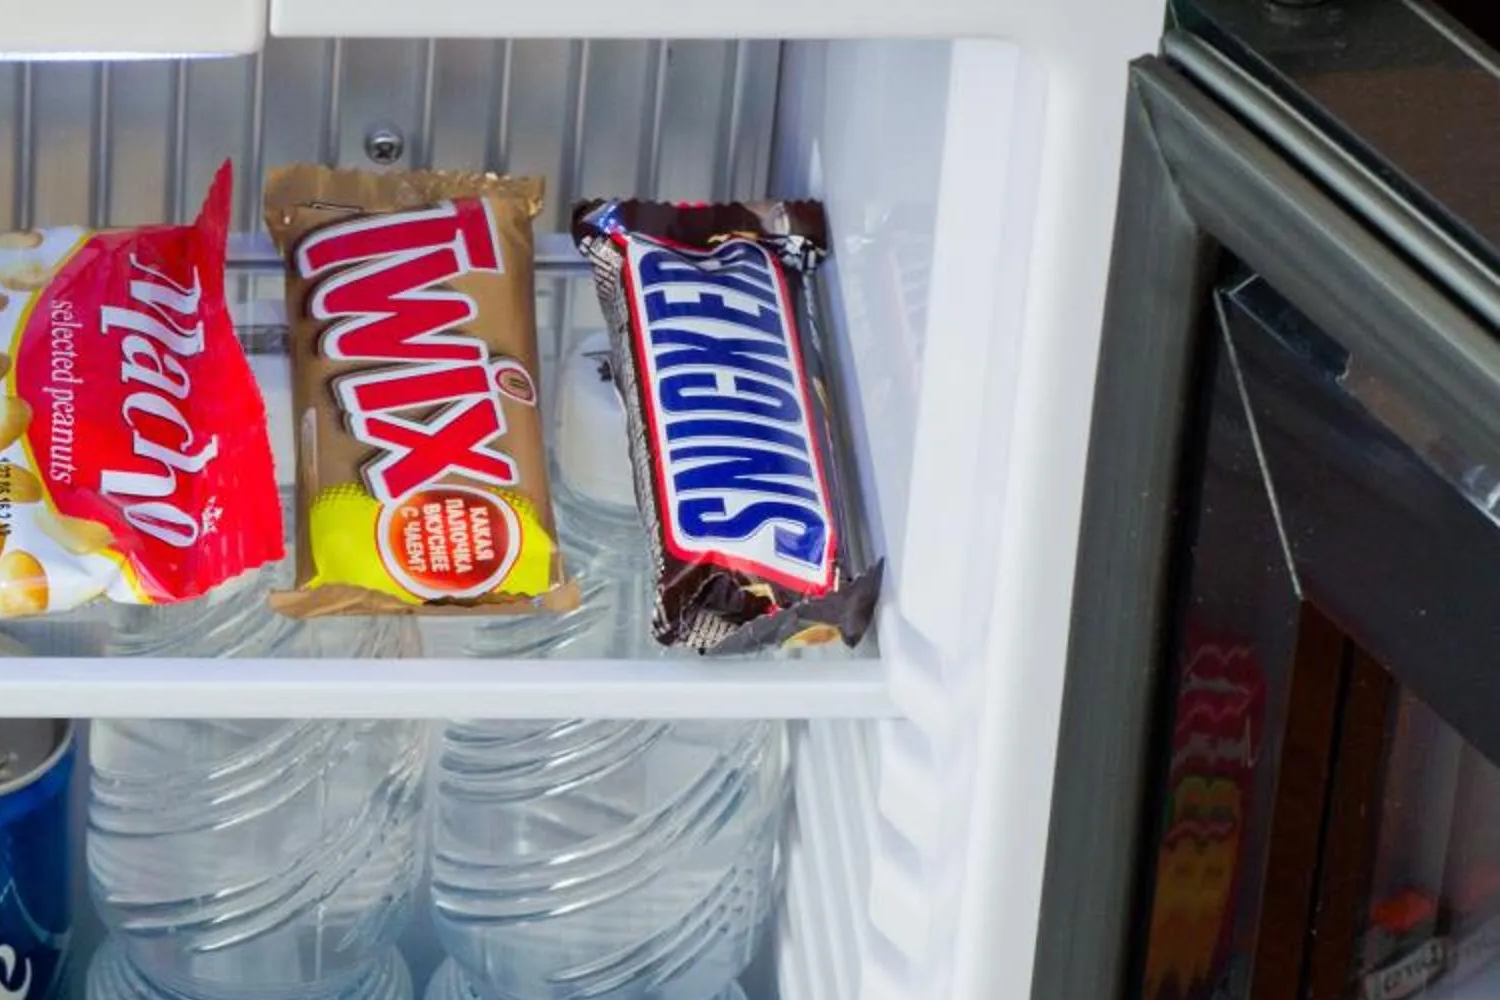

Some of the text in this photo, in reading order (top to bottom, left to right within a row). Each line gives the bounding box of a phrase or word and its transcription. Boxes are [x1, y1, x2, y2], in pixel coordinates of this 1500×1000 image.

[45, 299, 85, 485] selected peanuts
[100, 253, 219, 549] Macho
[638, 240, 828, 570] SNICKERS
[444, 497, 474, 574] ПАЛОЧКА
[468, 506, 495, 561] КАКАЯ
